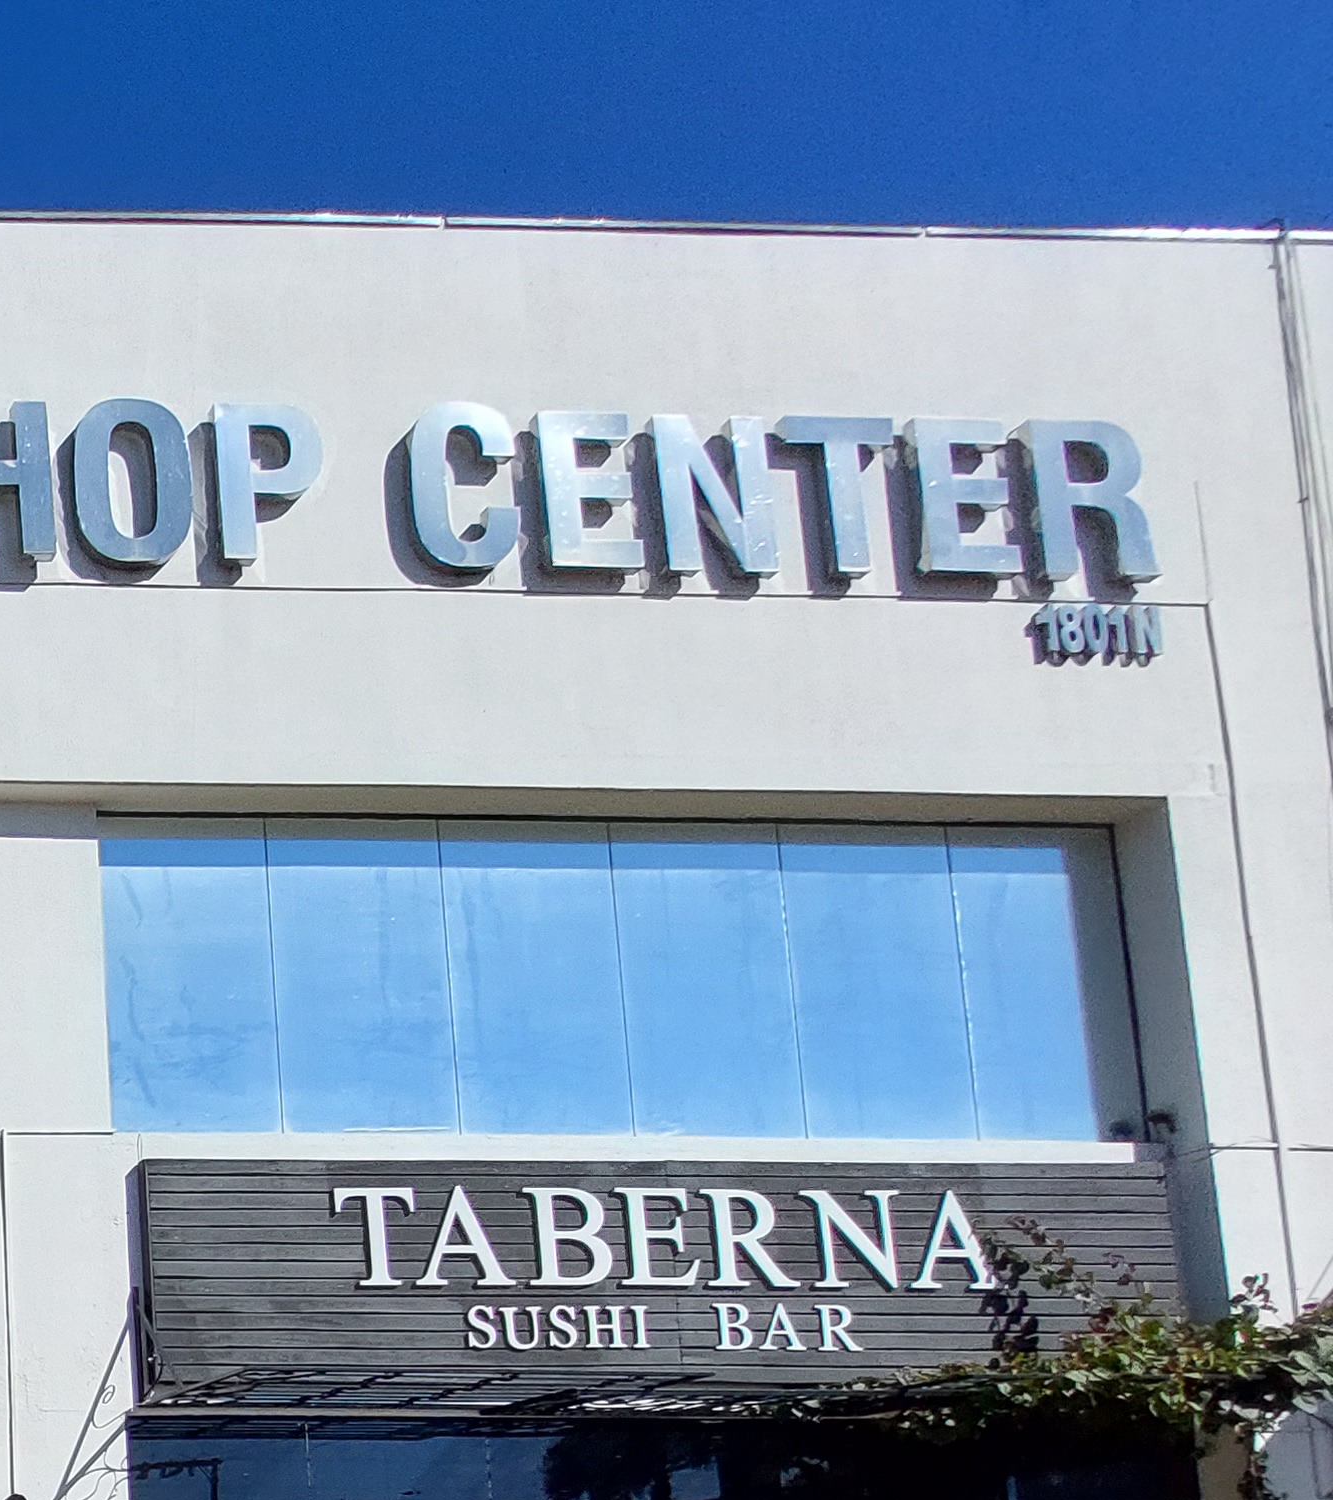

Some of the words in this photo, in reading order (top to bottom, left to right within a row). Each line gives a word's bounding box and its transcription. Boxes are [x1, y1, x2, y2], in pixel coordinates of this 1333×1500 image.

[409, 400, 1165, 581] CENTER
[1034, 602, 1165, 655] 1801N
[332, 1184, 998, 1291] TABERNA
[468, 1303, 649, 1351] SUSHI
[714, 1302, 864, 1353] BAR
